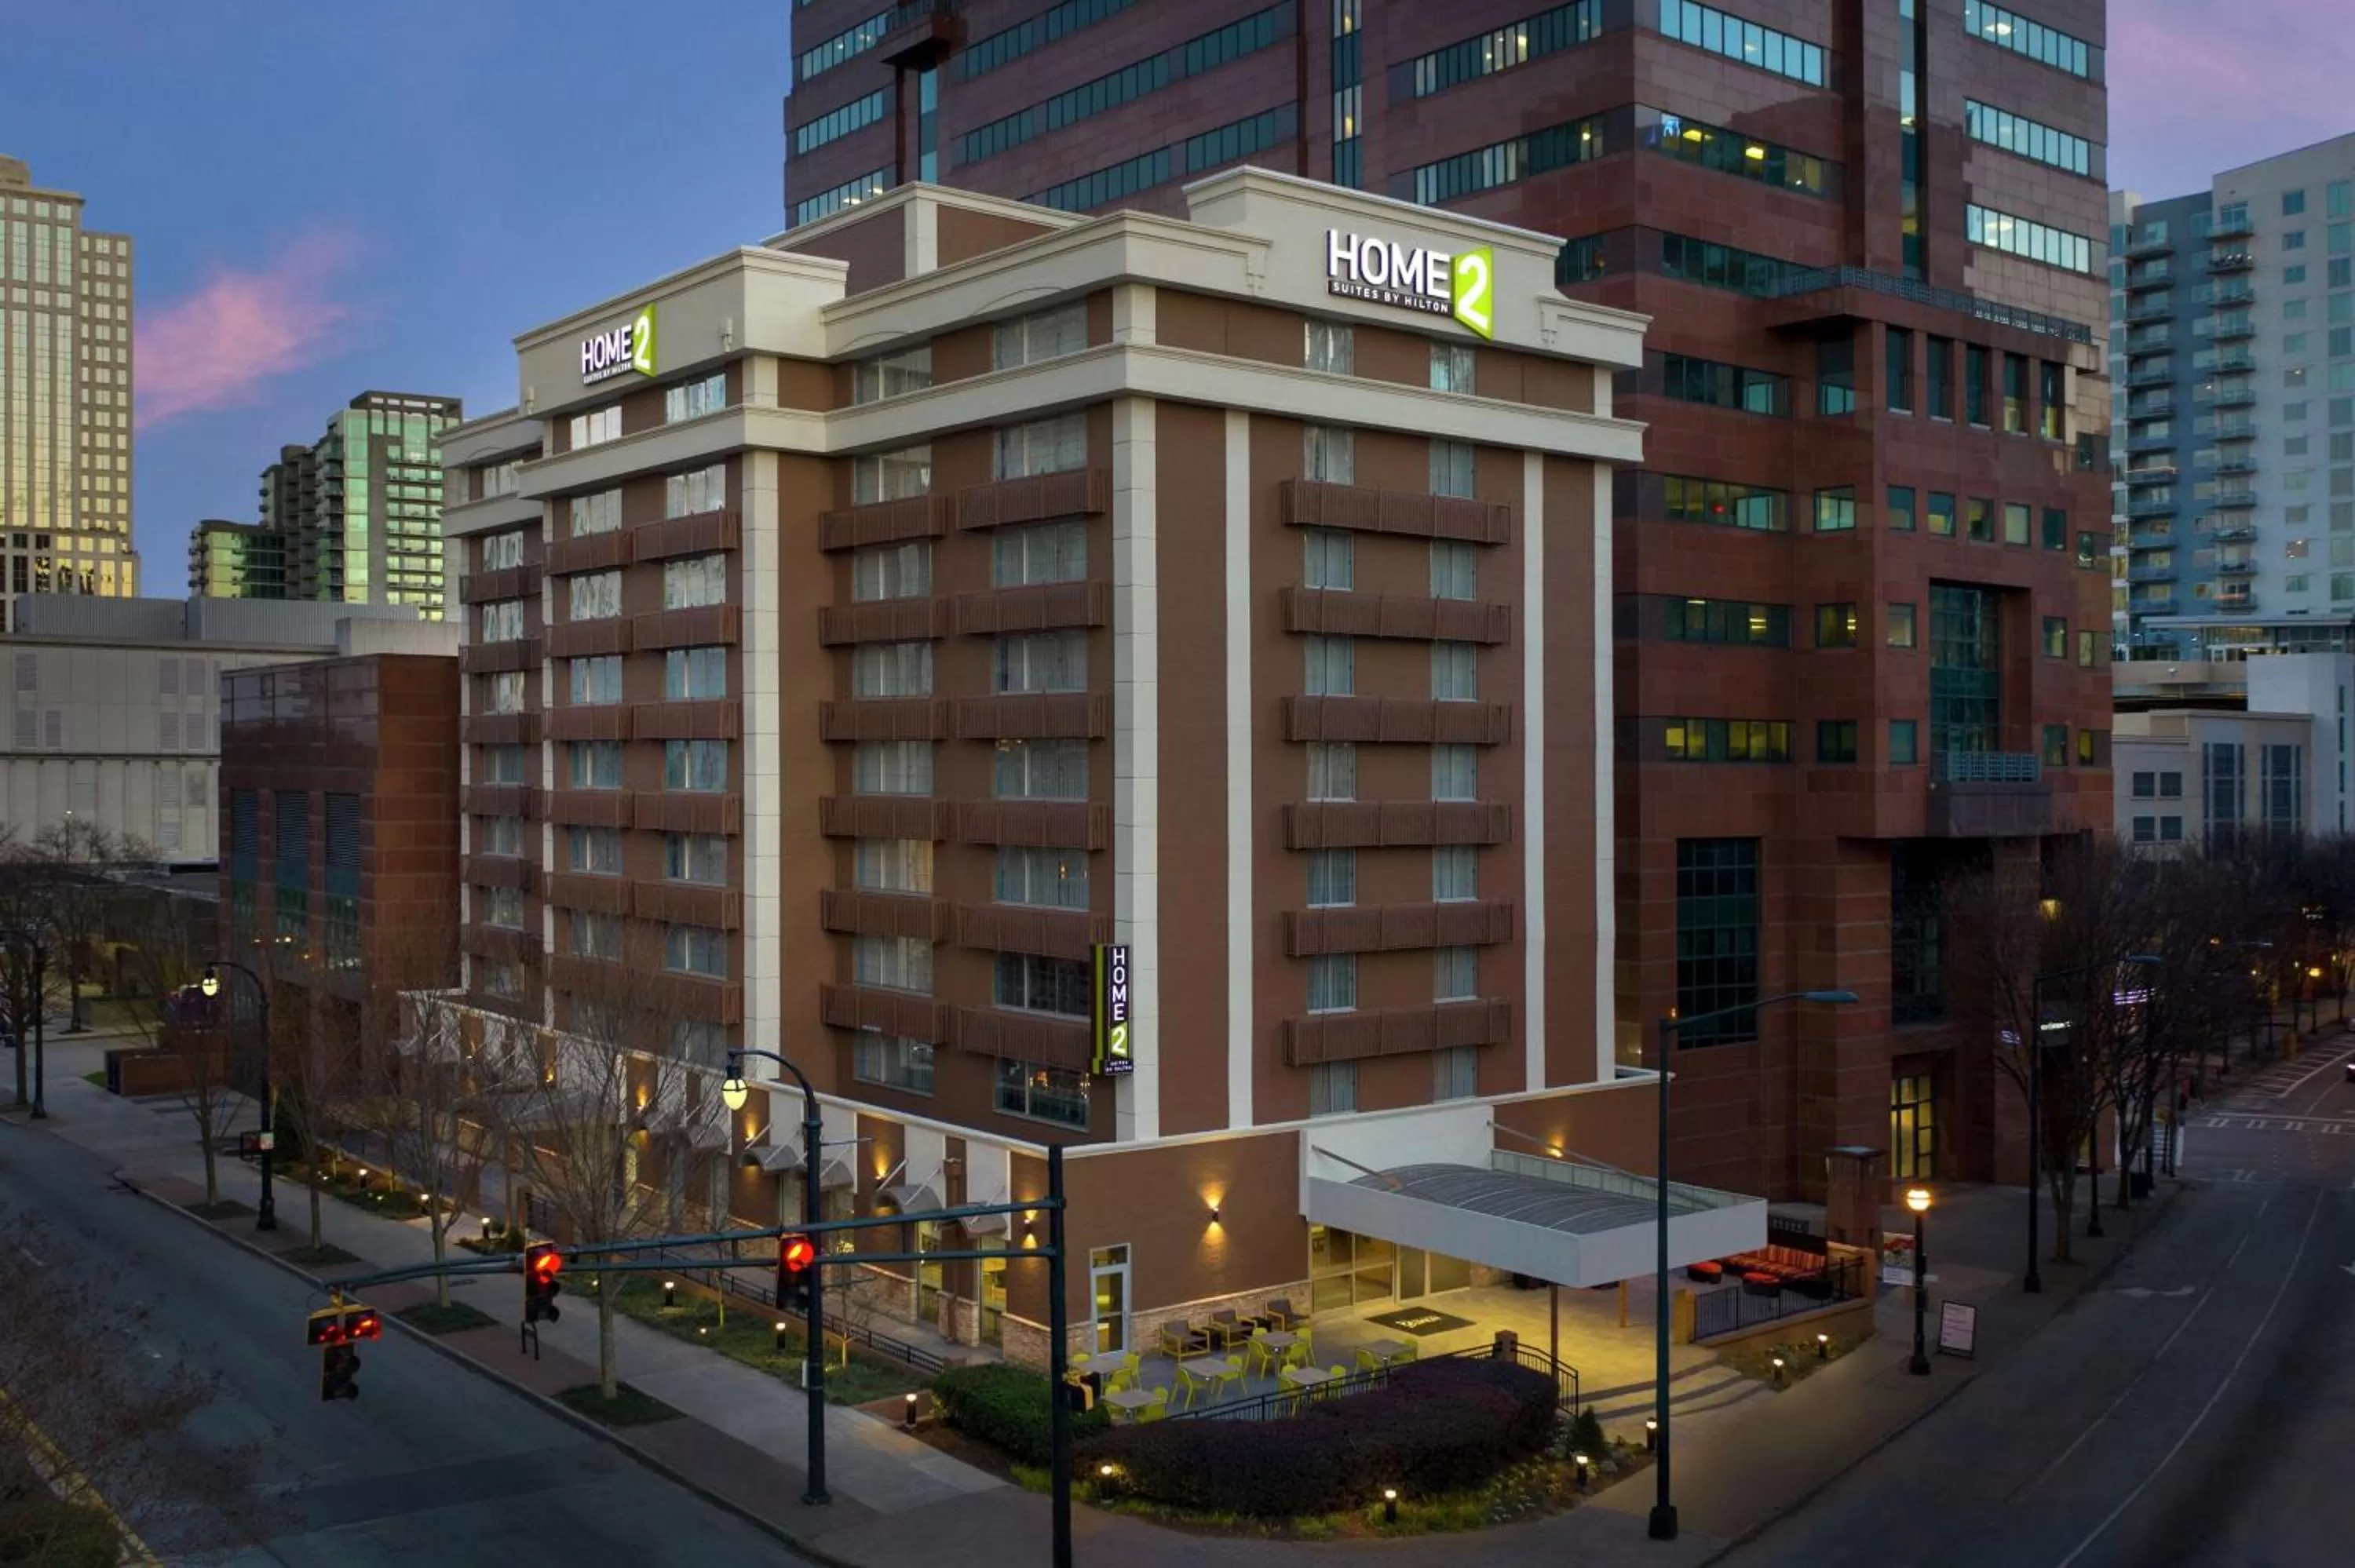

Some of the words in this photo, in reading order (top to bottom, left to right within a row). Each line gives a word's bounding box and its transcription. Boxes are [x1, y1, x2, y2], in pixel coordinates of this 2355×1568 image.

[1328, 228, 1450, 299] HOME
[1458, 254, 1488, 330] 2
[1334, 282, 1378, 300] SUITES
[1384, 290, 1400, 304] BY
[1404, 297, 1449, 313] HILTON
[582, 324, 632, 374] HOME
[634, 315, 651, 370] 2
[1112, 947, 1126, 1021] HOME
[1112, 1026, 1126, 1056] 2
